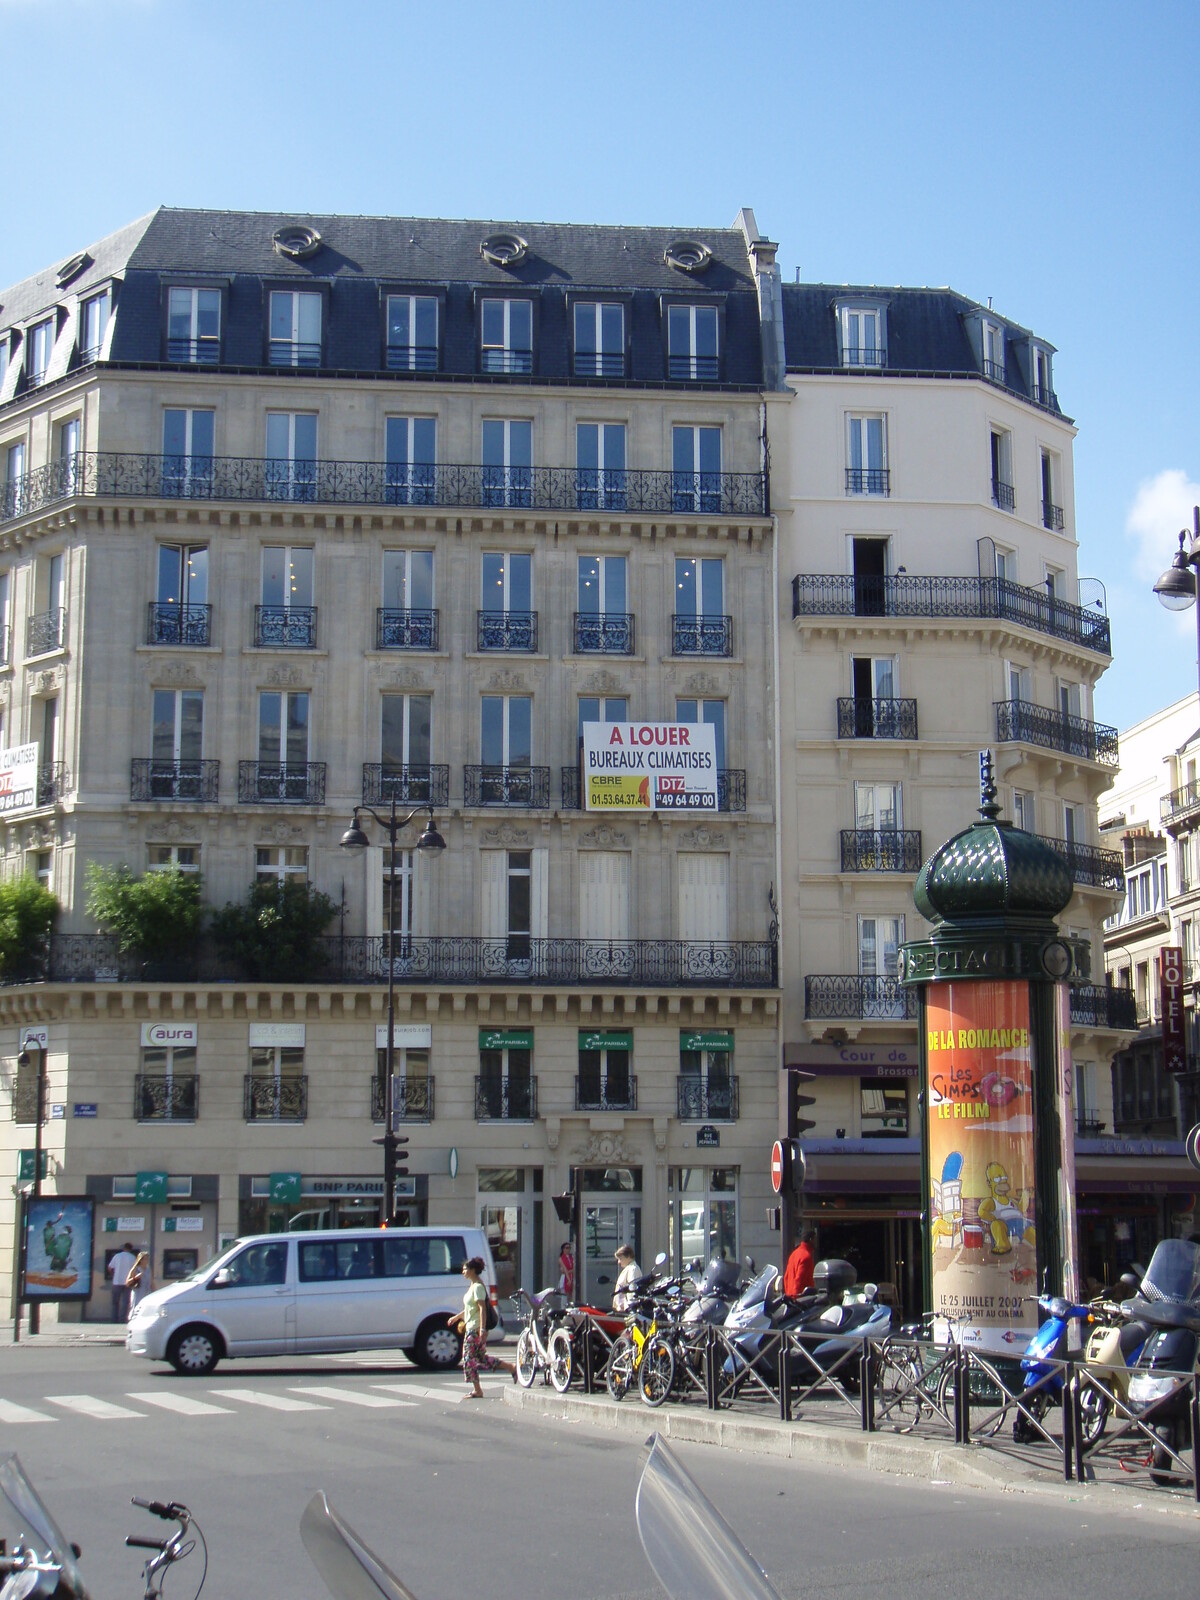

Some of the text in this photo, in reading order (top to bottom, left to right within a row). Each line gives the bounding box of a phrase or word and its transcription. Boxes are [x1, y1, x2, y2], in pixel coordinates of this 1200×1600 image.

[609, 726, 691, 746] A LOUER
[3, 747, 35, 769] CLIMATISES
[589, 751, 712, 769] BUREAUX CLIMATISES
[591, 776, 623, 785] CBRE
[661, 777, 686, 791] DTZ
[592, 794, 647, 805] 01.53.64.37.41
[662, 794, 674, 806] 49
[675, 795, 688, 806] 64
[689, 795, 701, 806] 49
[702, 795, 714, 806] 00
[1164, 950, 1180, 1033] HOTEL
[156, 1029, 193, 1039] aura
[928, 1028, 1028, 1051] DE LA ROMANCE
[839, 1049, 907, 1061] Cour de
[938, 1102, 990, 1119] LE FILM
[313, 1182, 407, 1192] BNP PARIS
[940, 1294, 1022, 1308] LE 25 JUILLET 2007
[986, 1310, 996, 1318] AU
